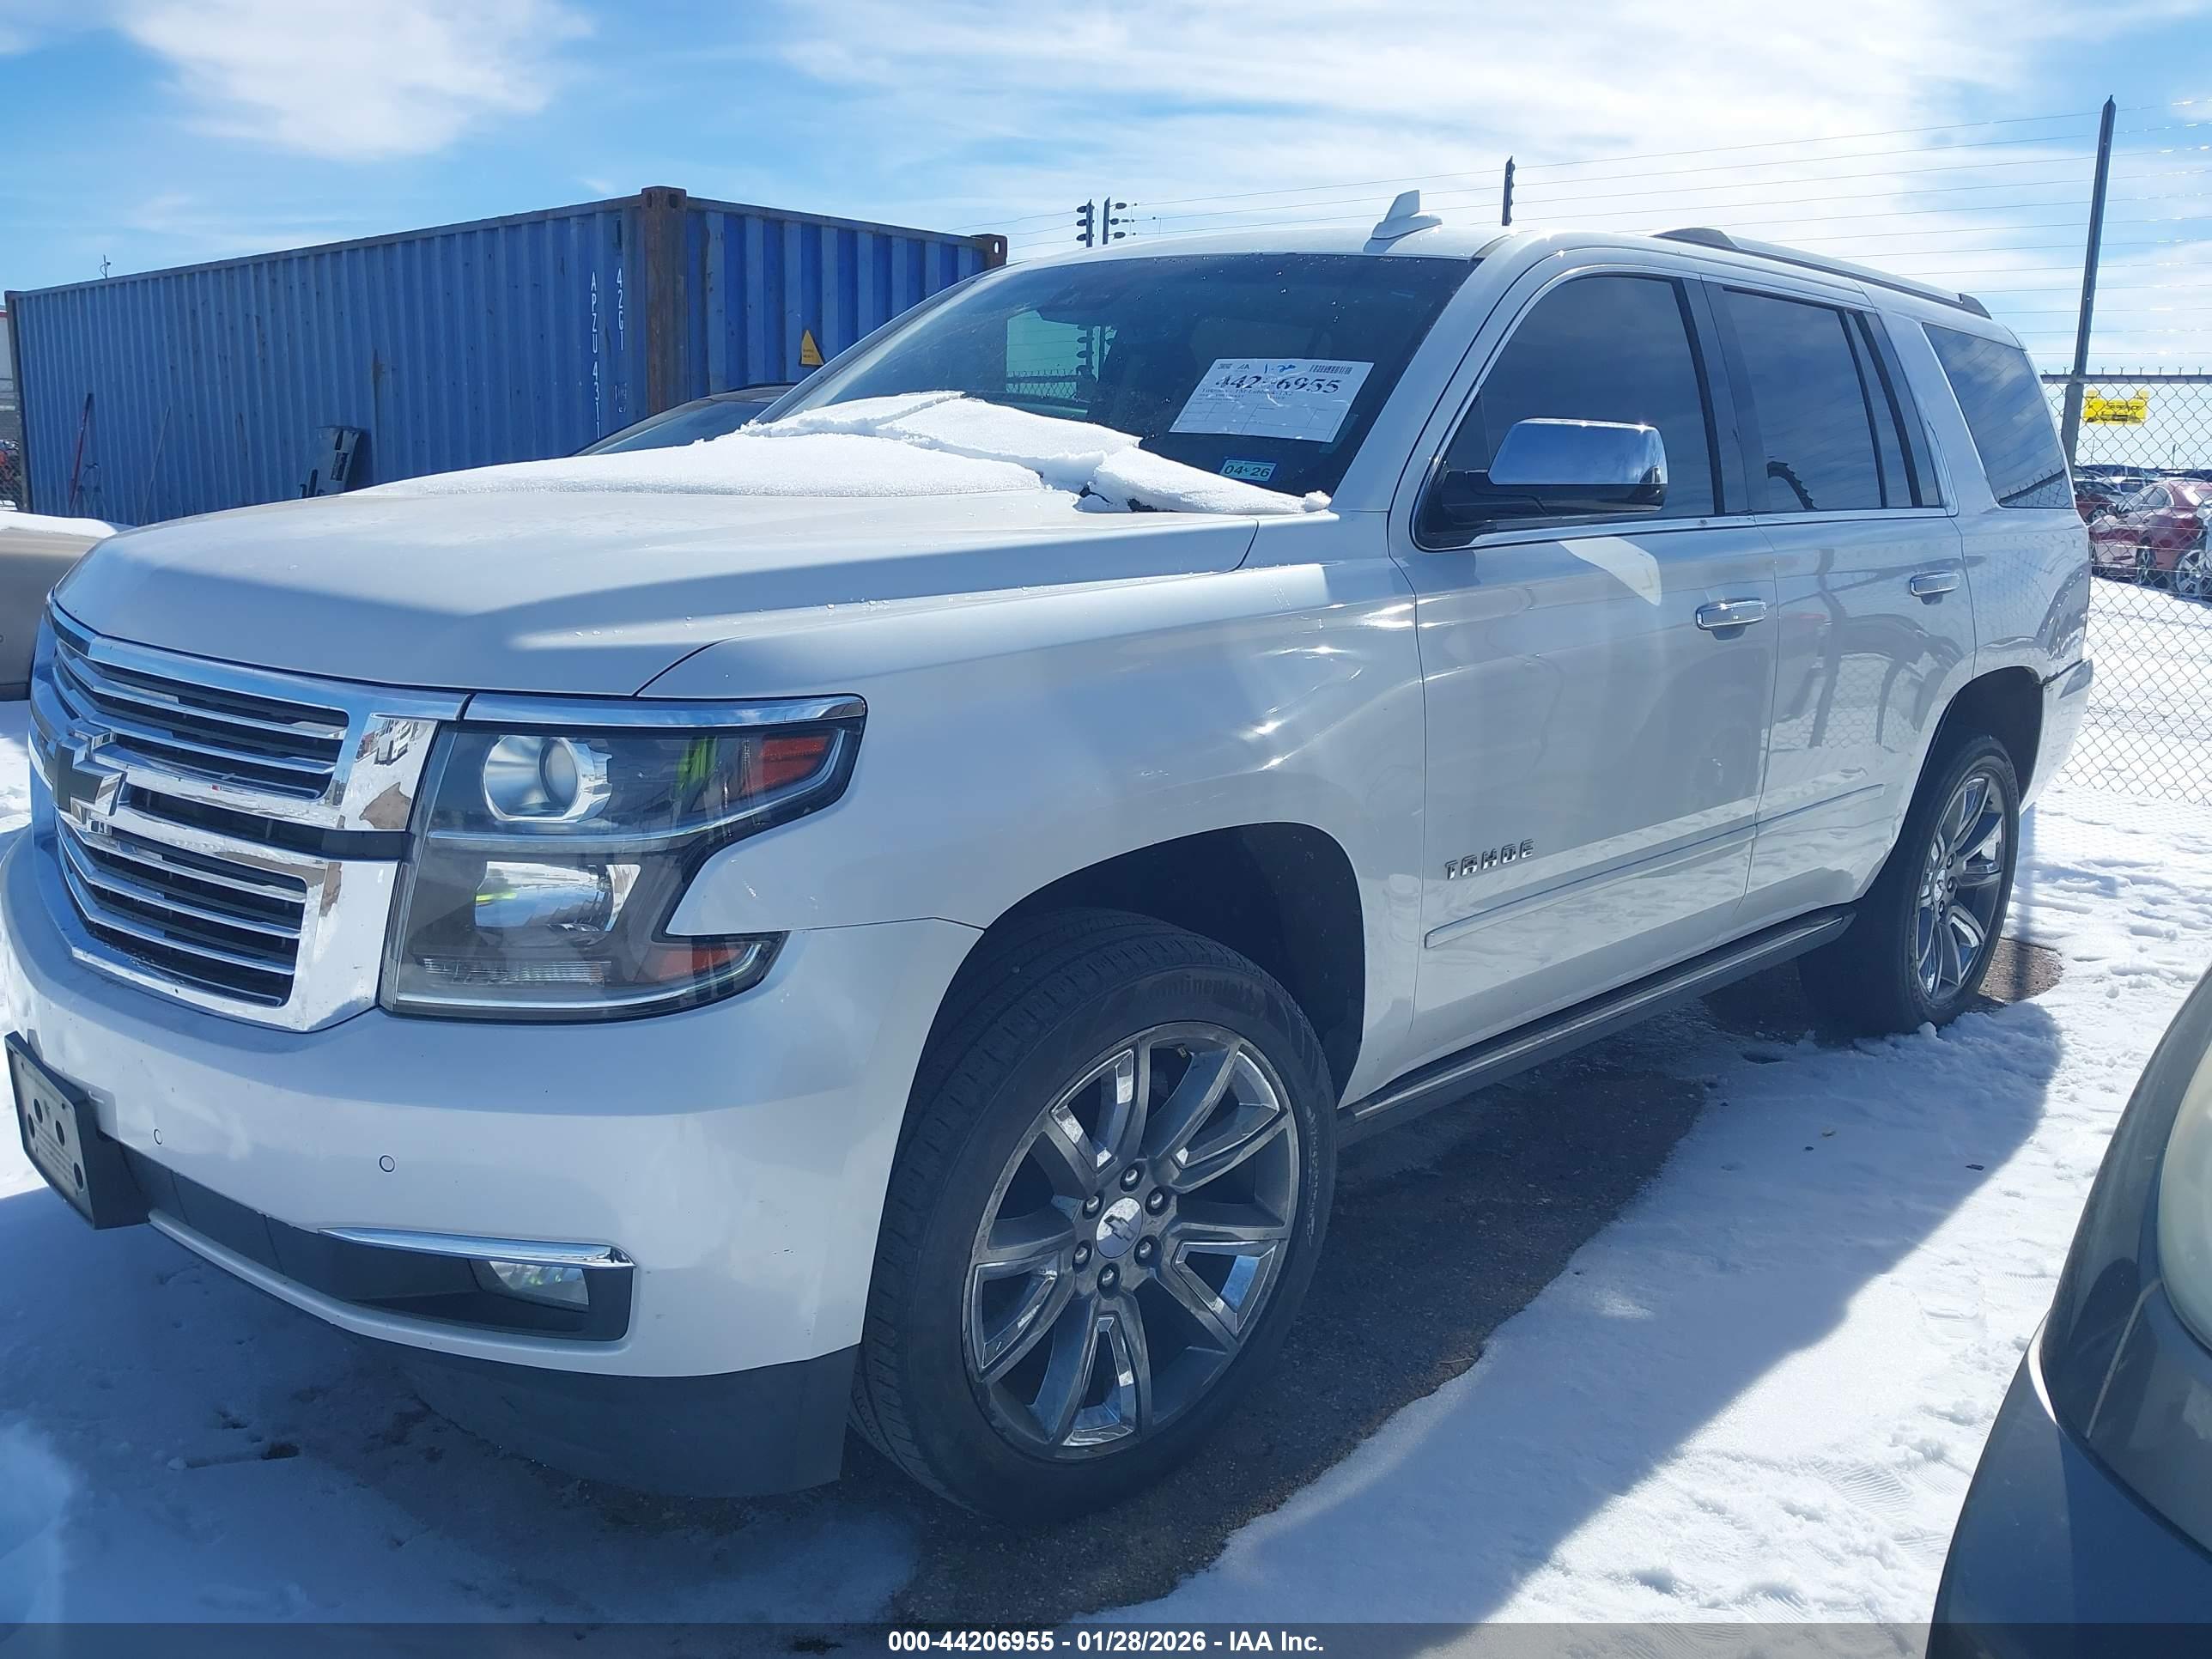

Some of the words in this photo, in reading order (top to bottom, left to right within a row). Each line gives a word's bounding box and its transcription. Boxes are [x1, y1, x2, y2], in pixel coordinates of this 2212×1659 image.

[1224, 465, 1244, 475] 04
[1249, 466, 1272, 477] 26
[1444, 838, 1534, 880] TAHOE
